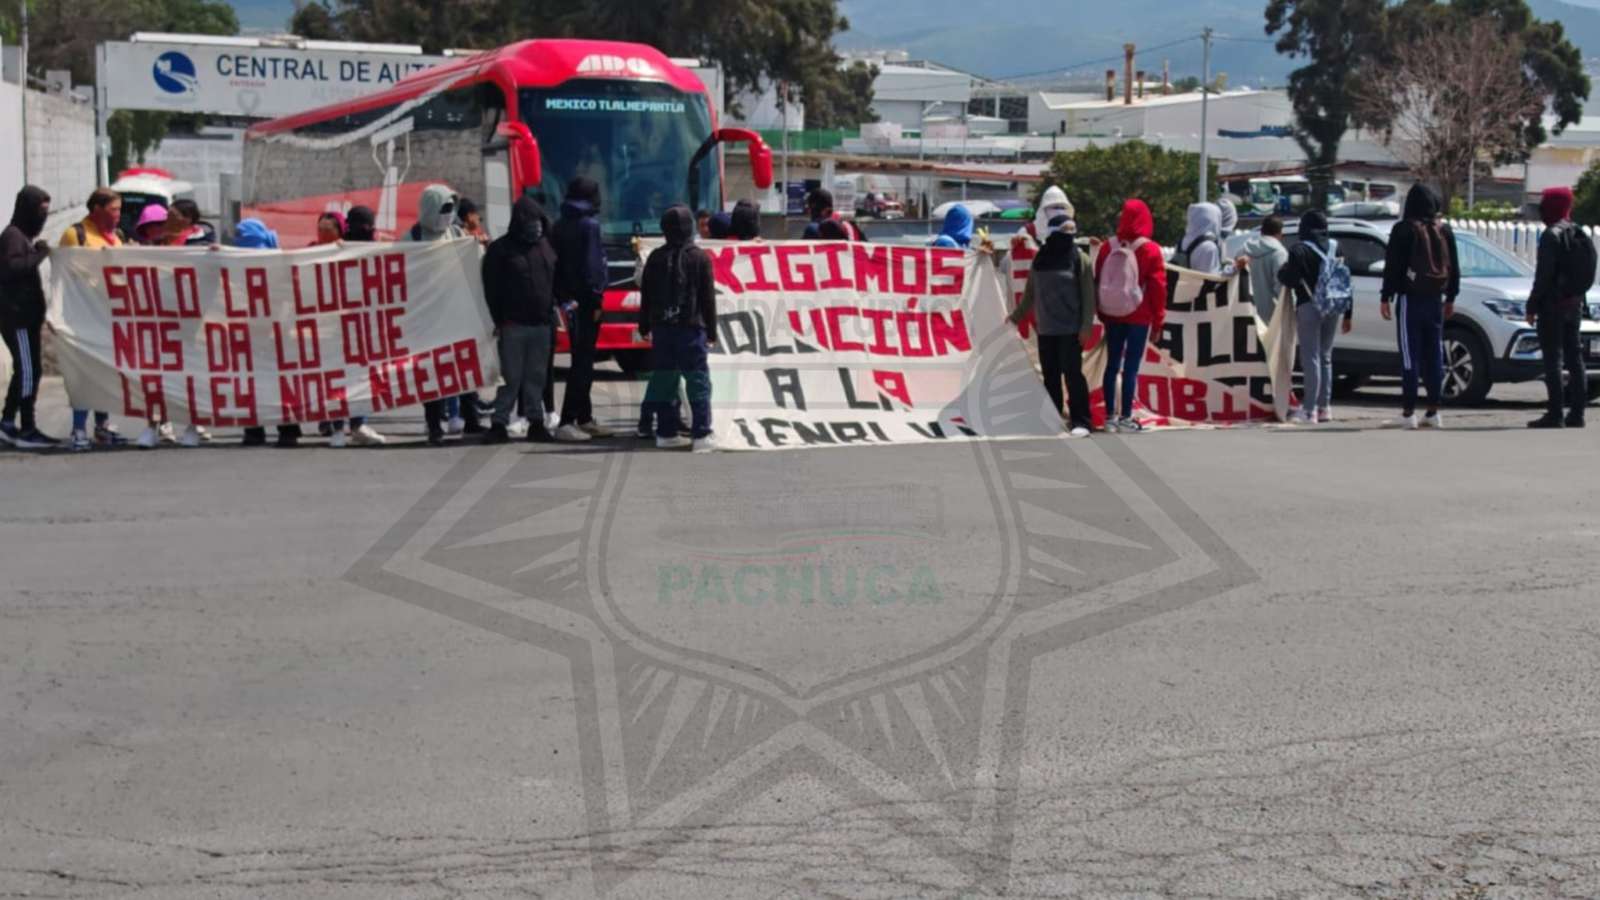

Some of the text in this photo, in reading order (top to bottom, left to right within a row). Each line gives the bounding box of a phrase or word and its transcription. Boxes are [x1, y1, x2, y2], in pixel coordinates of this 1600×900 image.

[217, 54, 329, 82] CENTRAL
[340, 60, 370, 83] DE
[545, 98, 597, 110] MEXICO
[103, 253, 408, 318] SOLO LA LUCHA
[711, 243, 965, 296] XIGIMOS
[112, 307, 410, 372] NOS DA LO QUE
[715, 297, 972, 358] OLUCIÓN
[120, 338, 484, 427] LA LEY NOS NIEGA
[764, 367, 914, 411] A LA
